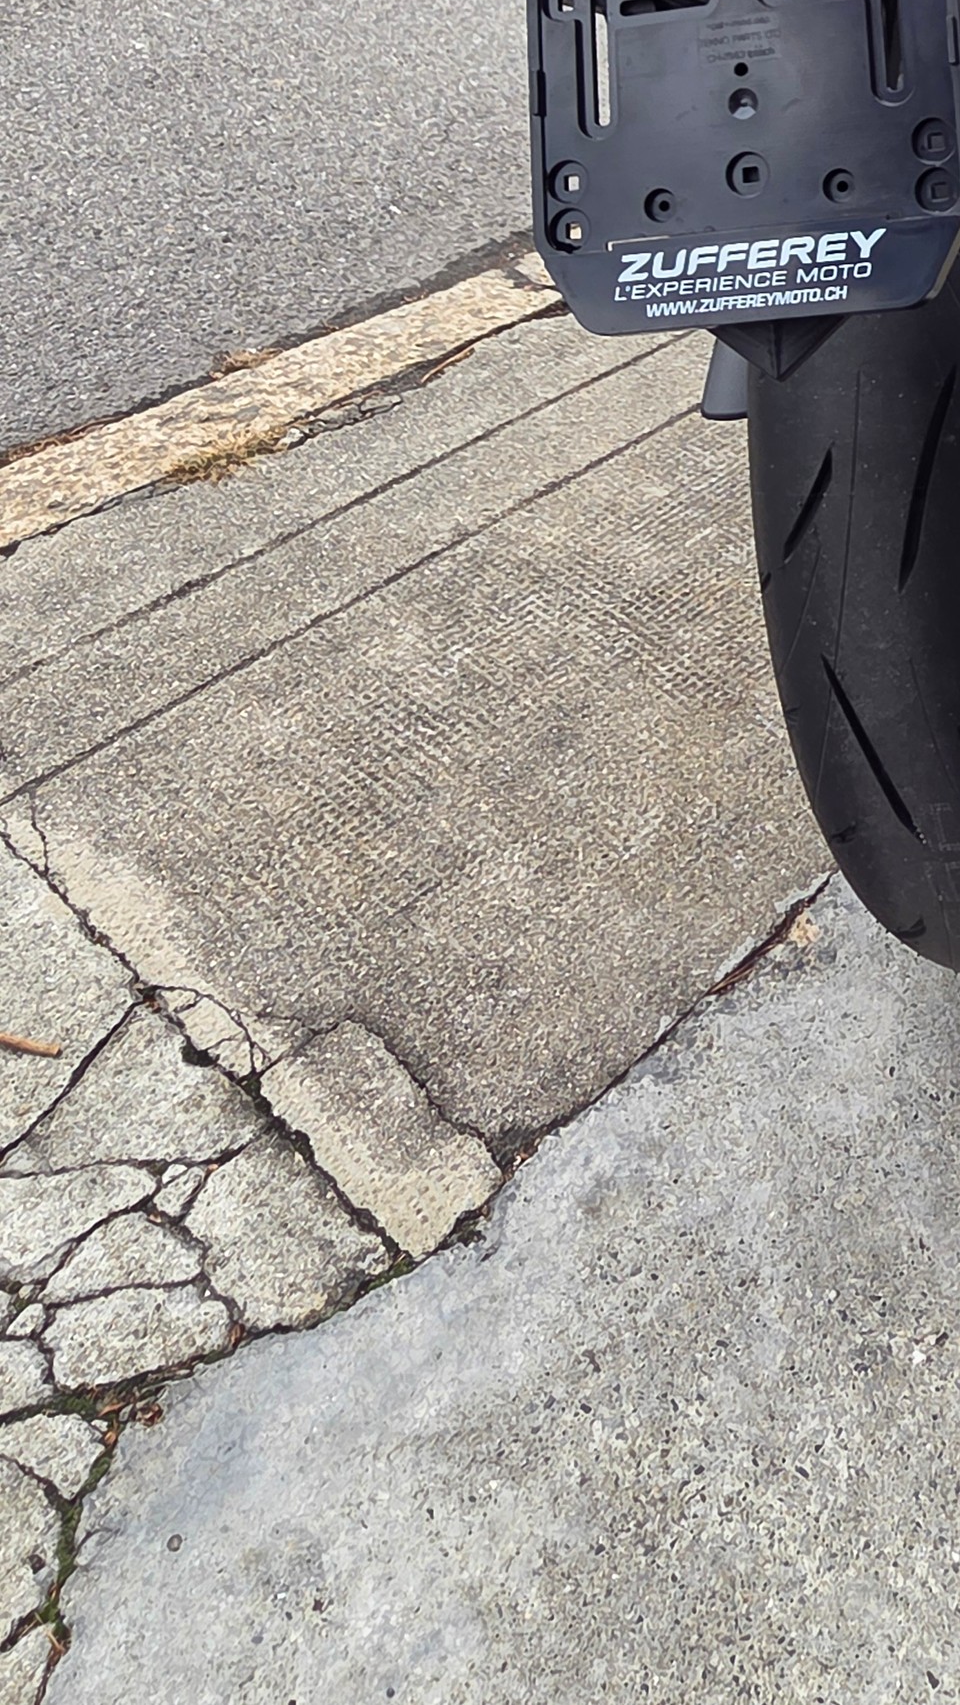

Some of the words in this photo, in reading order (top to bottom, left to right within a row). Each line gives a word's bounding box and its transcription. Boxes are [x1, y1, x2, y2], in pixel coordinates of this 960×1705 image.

[617, 228, 887, 283] ZUFFEREY
[613, 270, 788, 302] L'EXPERIENCE
[795, 261, 873, 285] MOTO
[646, 285, 848, 318] WWW.ZUFFEREYMOTO.CH
